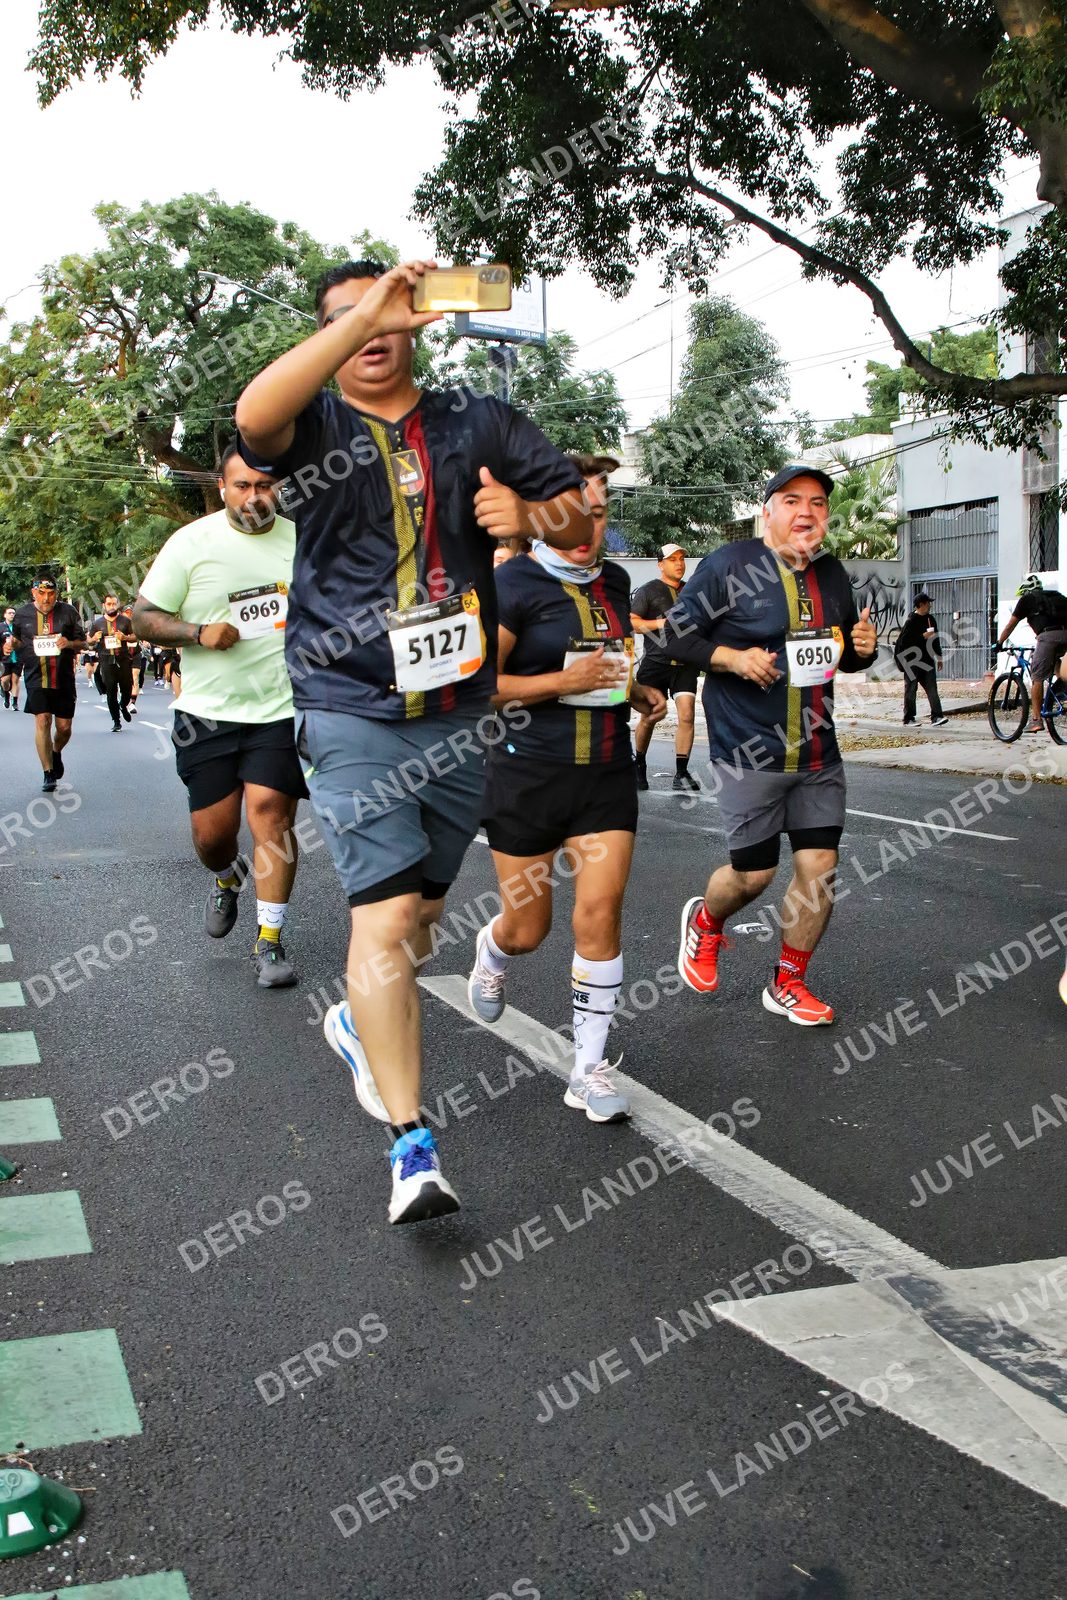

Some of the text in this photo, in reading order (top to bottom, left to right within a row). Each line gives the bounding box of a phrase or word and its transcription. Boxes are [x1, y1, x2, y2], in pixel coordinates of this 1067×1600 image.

[240, 599, 280, 622] 6969
[464, 597, 476, 609] 5K
[37, 641, 56, 649] 6593
[408, 623, 467, 666] 5127
[796, 645, 832, 667] 6950
